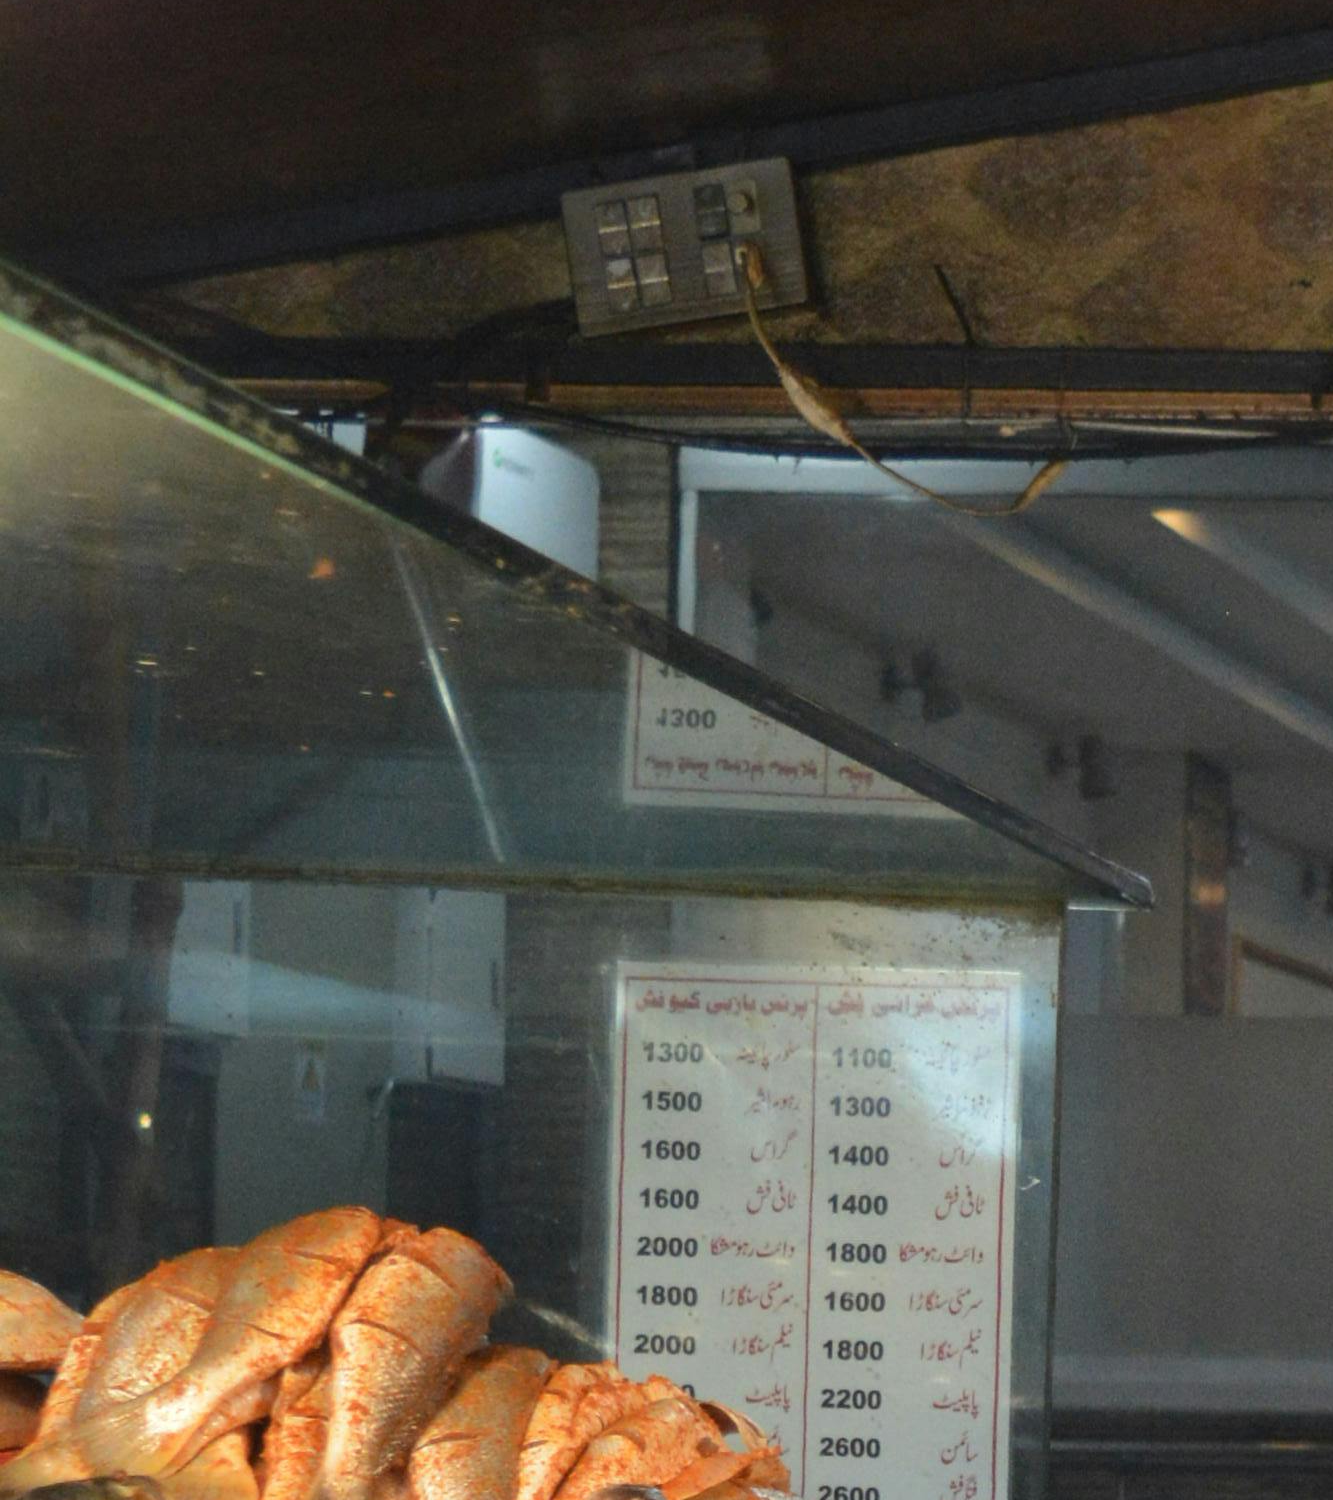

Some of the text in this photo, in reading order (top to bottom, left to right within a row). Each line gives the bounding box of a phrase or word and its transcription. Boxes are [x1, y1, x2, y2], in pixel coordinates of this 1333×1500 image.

[642, 1041, 704, 1064] 1300
[832, 1046, 892, 1069] 1100
[641, 1090, 702, 1112] 1500
[829, 1096, 891, 1118] 1300
[640, 1140, 701, 1162] 1600
[828, 1146, 889, 1167] 1400
[639, 1188, 700, 1210] 1600
[827, 1194, 889, 1216] 1400
[636, 1236, 699, 1258] 2000
[826, 1242, 887, 1265] 1800
[636, 1285, 698, 1307] 1800
[824, 1291, 886, 1313] 1600
[633, 1335, 696, 1357] 2000
[822, 1340, 884, 1362] 1800
[820, 1389, 882, 1411] 2200
[819, 1437, 881, 1459] 2600
